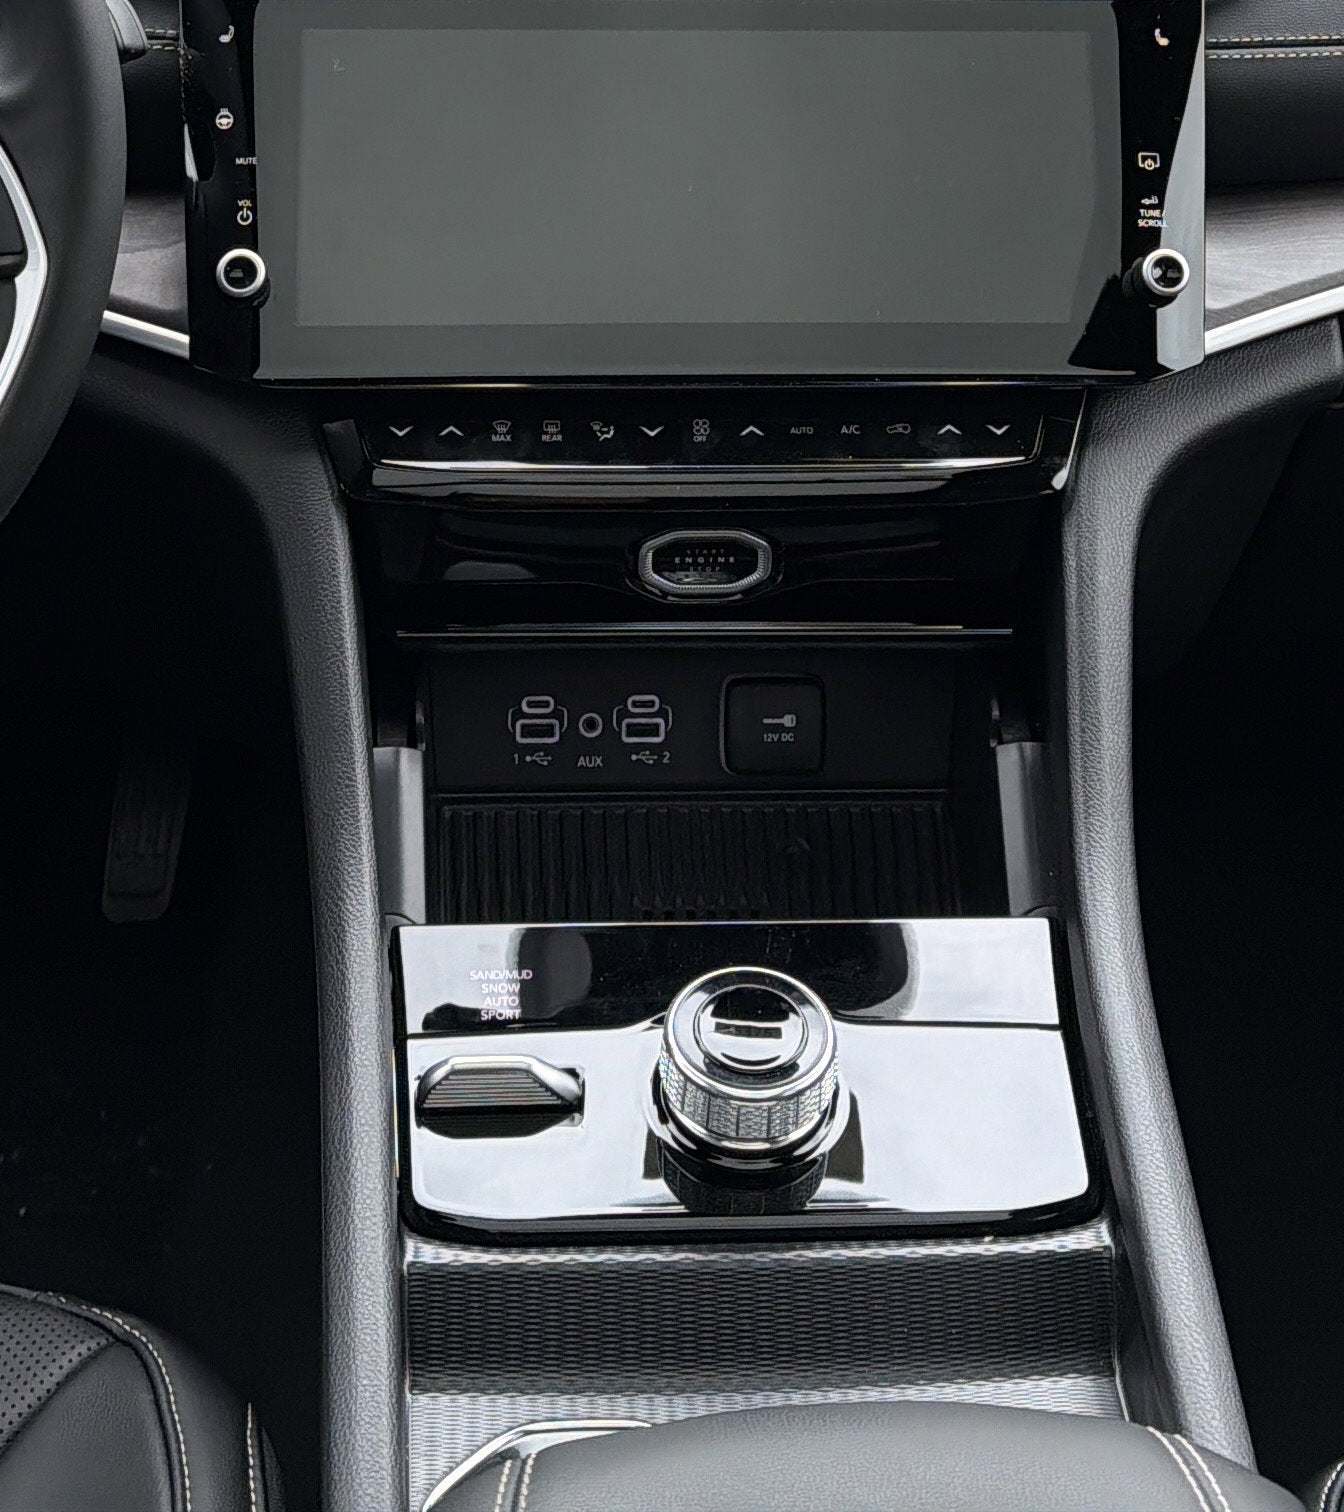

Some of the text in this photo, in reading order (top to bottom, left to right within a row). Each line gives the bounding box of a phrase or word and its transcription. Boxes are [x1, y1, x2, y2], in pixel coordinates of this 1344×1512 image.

[235, 157, 258, 166] MUTE
[237, 199, 253, 207] VOL
[789, 426, 814, 435] AUTO
[840, 424, 861, 435] A/C
[491, 434, 512, 442] MAX
[541, 434, 563, 442] REAR
[693, 435, 707, 443] OFF
[674, 556, 735, 564] ENGINE
[763, 732, 795, 742] 12V DC
[576, 754, 604, 768] AUX
[662, 752, 671, 764] 2
[469, 969, 533, 981] SAND/MUD
[481, 982, 521, 994] SNOW
[484, 995, 520, 1007] AUTO
[480, 1008, 522, 1021] SPORT
